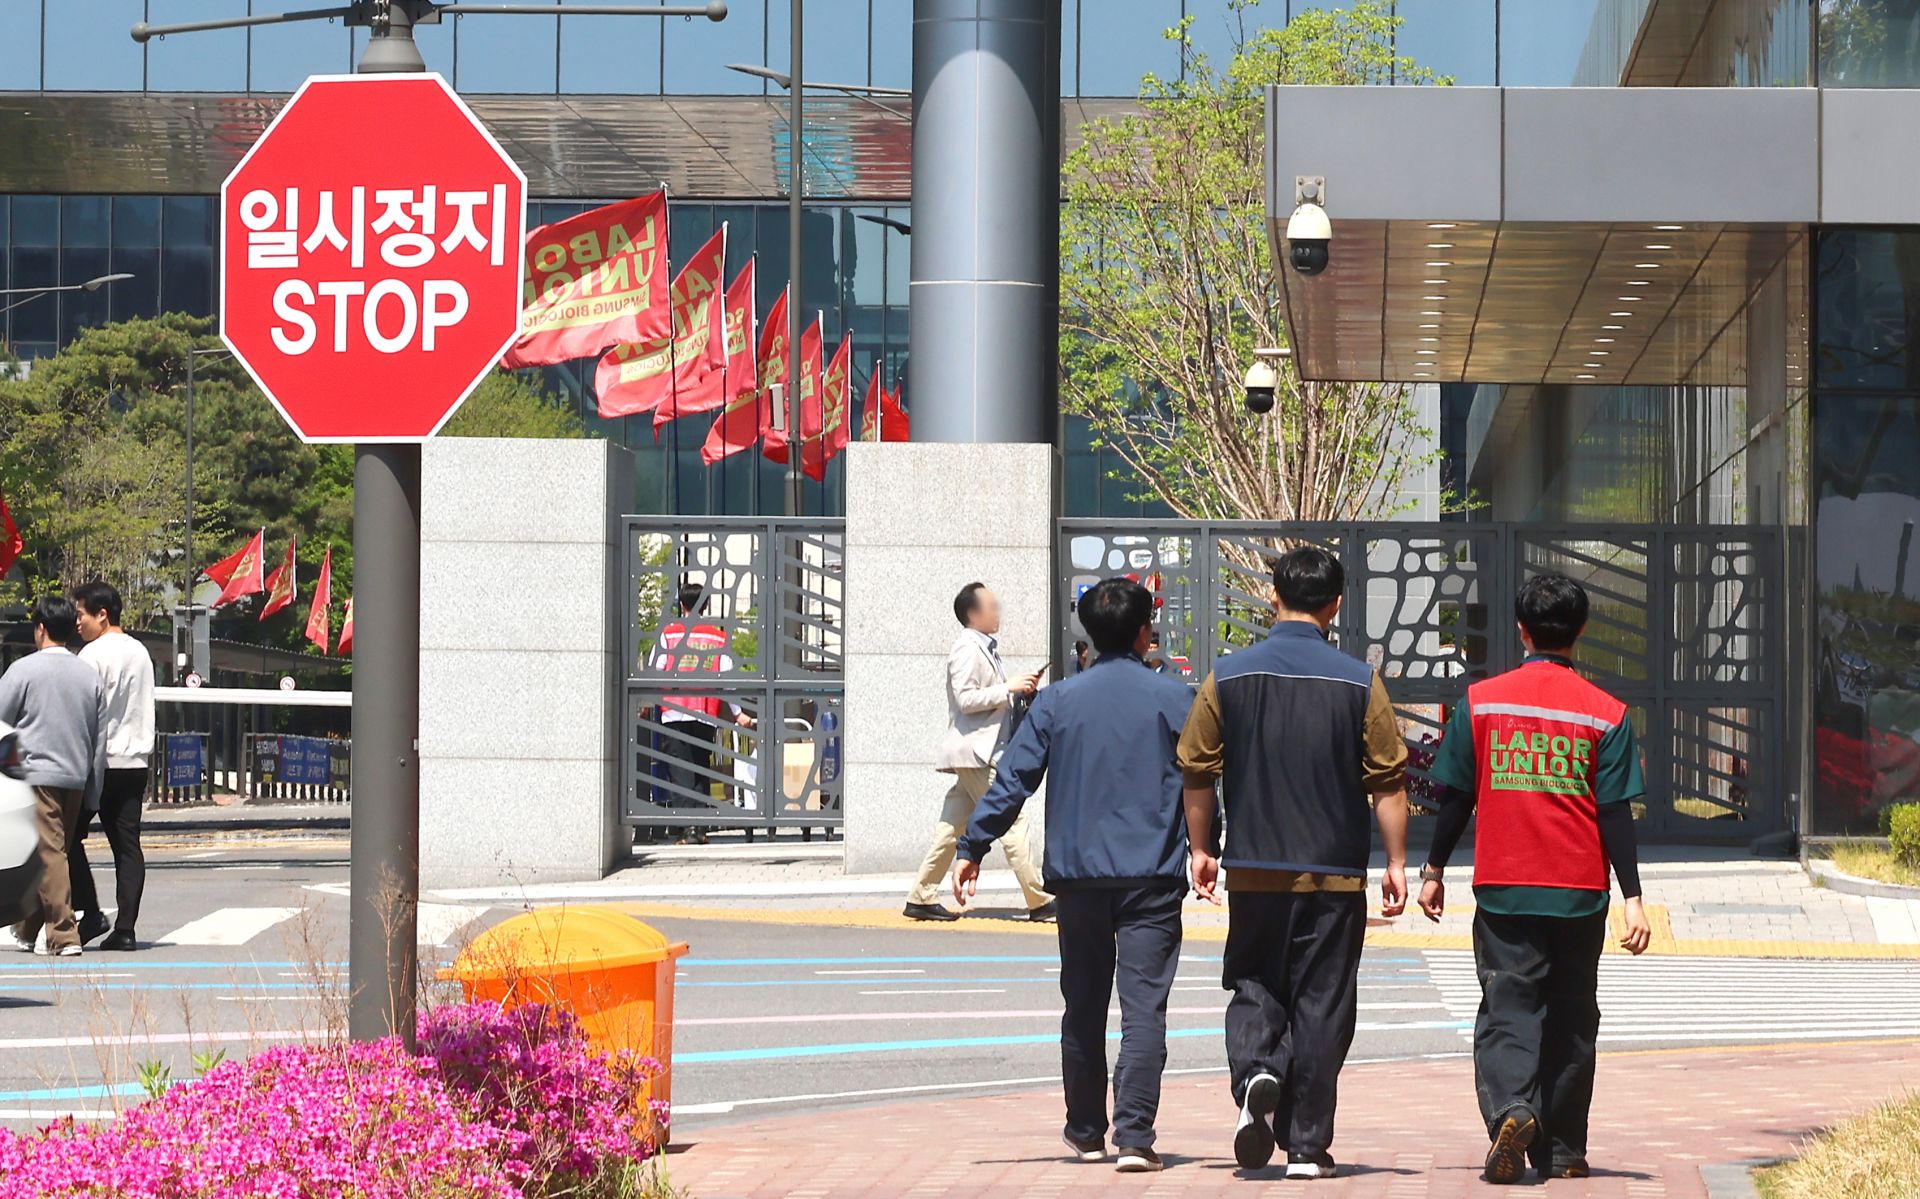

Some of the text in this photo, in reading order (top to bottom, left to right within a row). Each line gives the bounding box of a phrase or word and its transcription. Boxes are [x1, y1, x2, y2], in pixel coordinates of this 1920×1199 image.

[239, 184, 507, 268] 일시정지
[270, 278, 469, 356] STOP
[1491, 729, 1592, 759] LABOR
[1491, 751, 1590, 780] UNION
[1494, 776, 1538, 787] SAMSUNG
